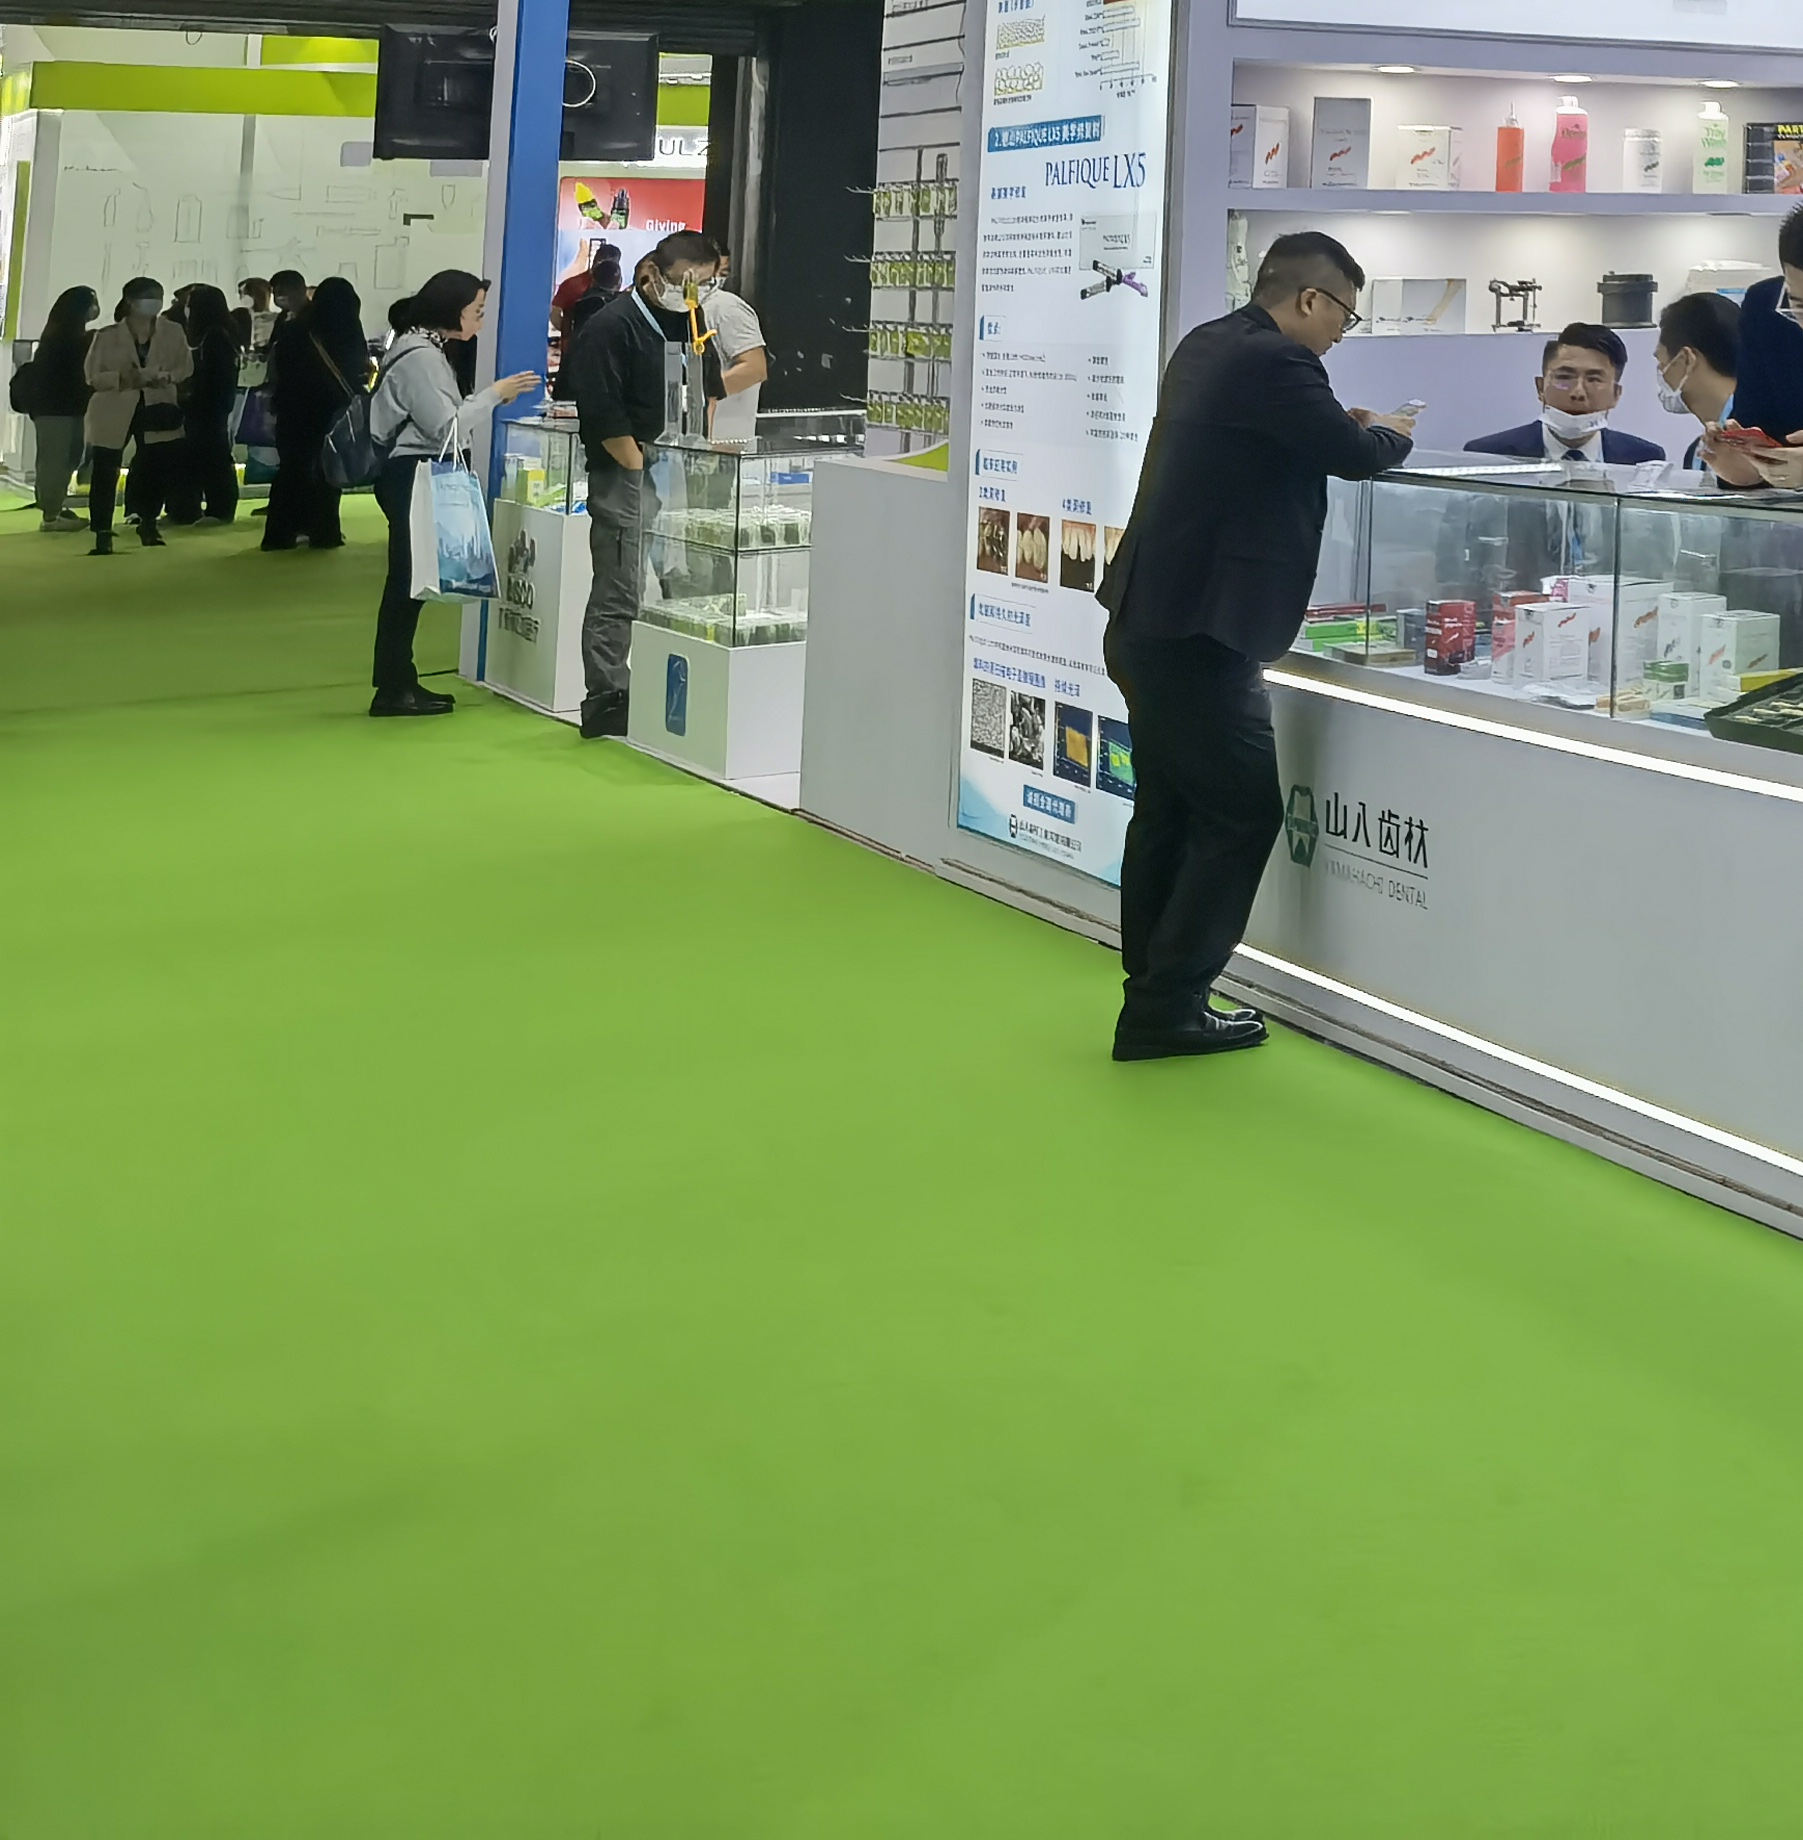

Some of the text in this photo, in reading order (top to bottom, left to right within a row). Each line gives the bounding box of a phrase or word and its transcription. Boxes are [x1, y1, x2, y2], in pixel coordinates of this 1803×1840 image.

[1045, 151, 1147, 190] PALFIQUE LX5
[1388, 879, 1429, 911] DENTAL
